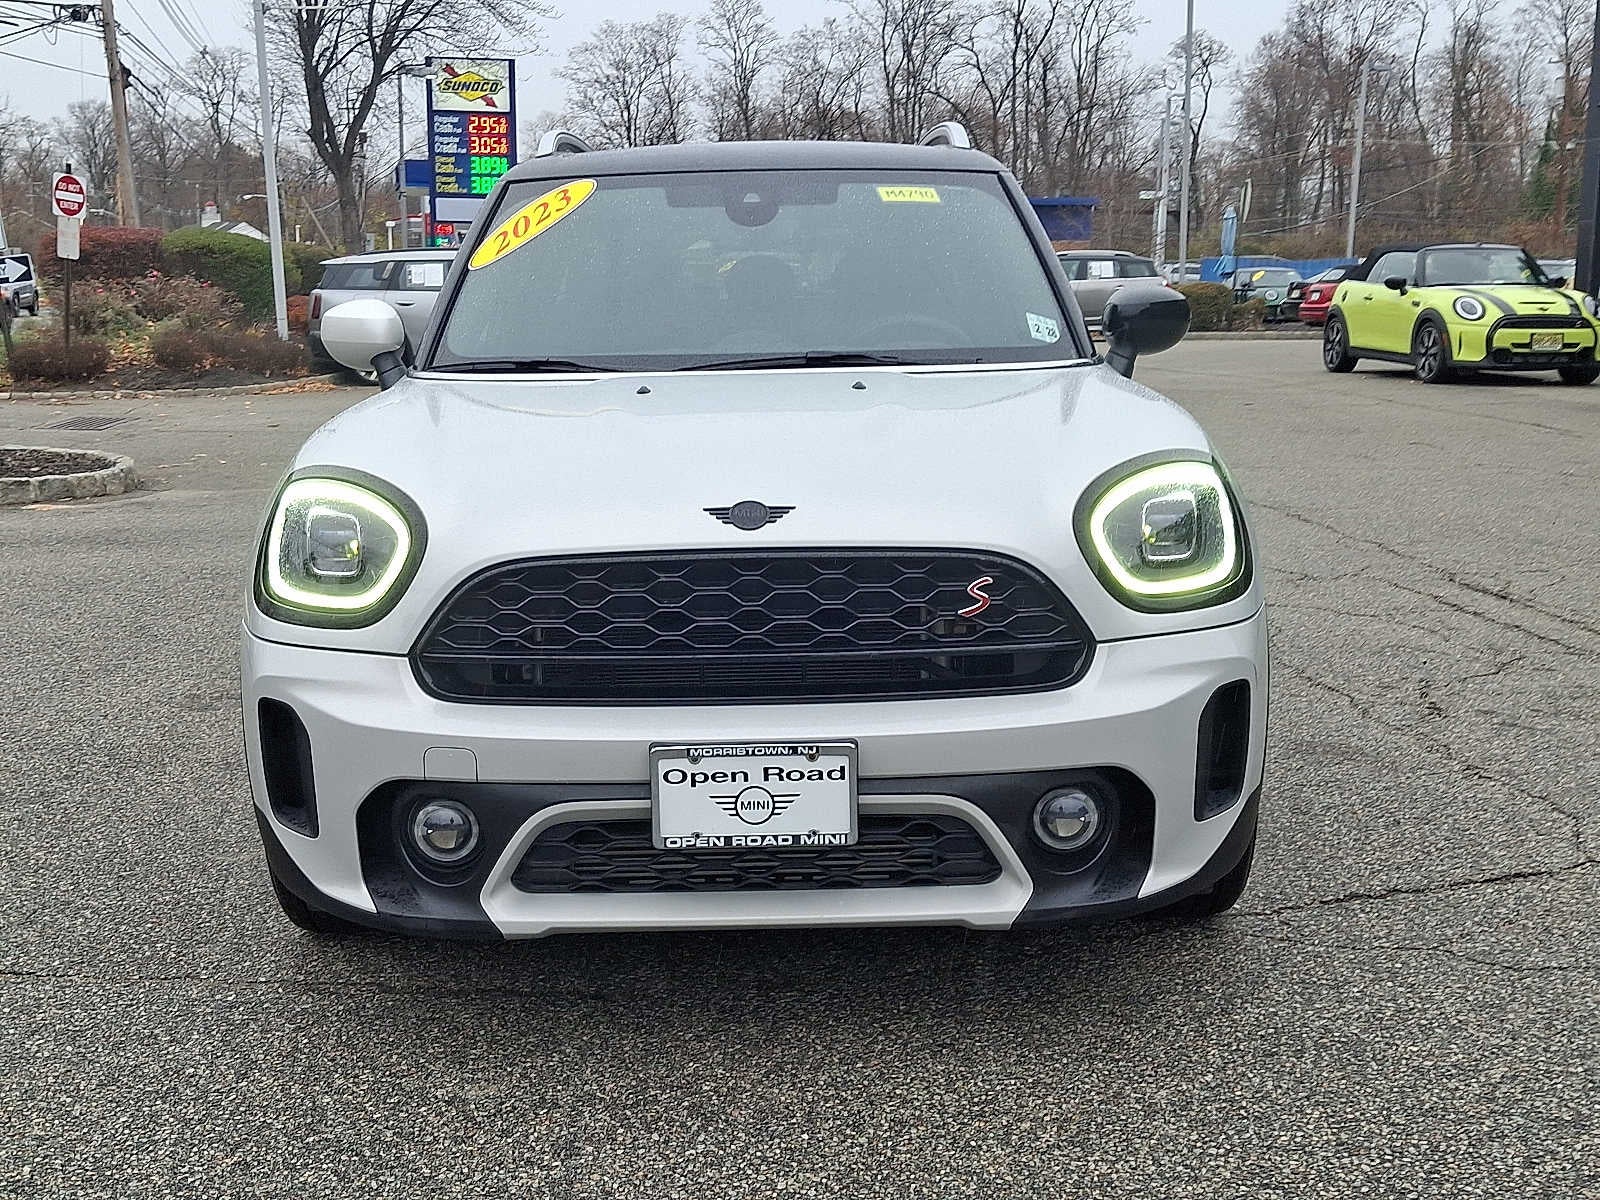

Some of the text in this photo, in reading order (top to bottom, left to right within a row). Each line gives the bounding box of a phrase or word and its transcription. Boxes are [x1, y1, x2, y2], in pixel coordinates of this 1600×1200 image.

[442, 80, 500, 92] SUNOCO
[57, 182, 80, 192] DO NOT
[60, 200, 79, 210] ENTER
[493, 188, 572, 256] 2023
[957, 576, 994, 618] S
[689, 746, 817, 757] MORRISTOWN, NJ
[662, 765, 846, 787] Open Road
[740, 800, 770, 811] MINI
[665, 834, 846, 848] OPEN ROAD MINI
